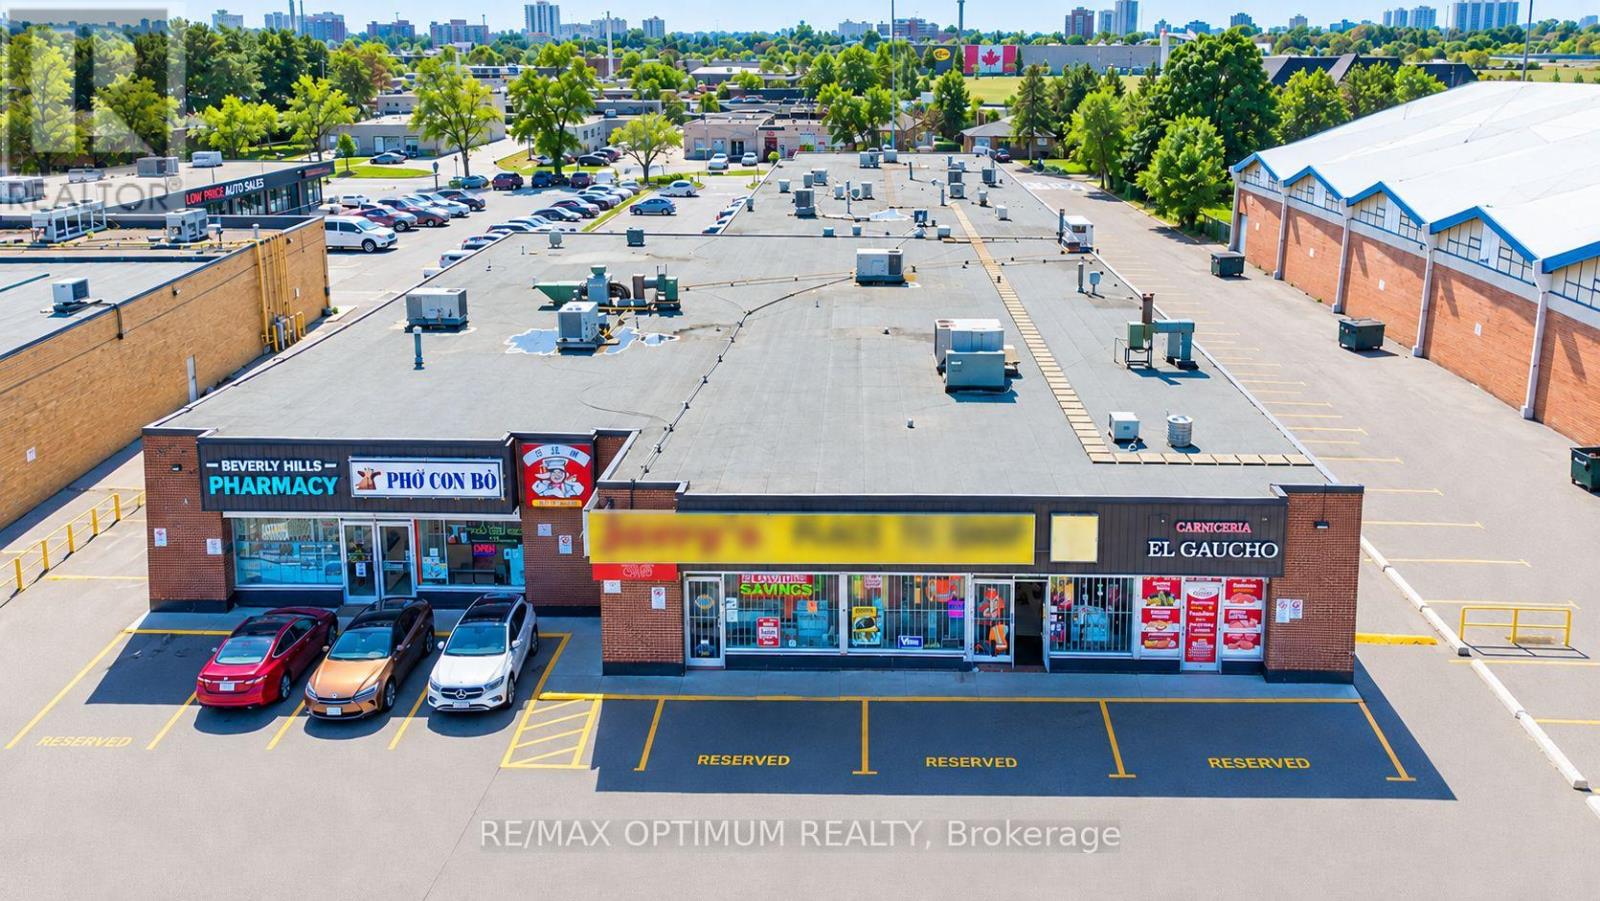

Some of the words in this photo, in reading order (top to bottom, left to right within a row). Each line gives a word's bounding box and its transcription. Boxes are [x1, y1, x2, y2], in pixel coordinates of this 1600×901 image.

[186, 193, 202, 205] LOW
[204, 186, 224, 200] PRICE
[225, 182, 243, 196] AUTO
[244, 178, 264, 192] SALES
[221, 460, 280, 472] BEVERLY
[283, 460, 322, 472] HILLS
[209, 476, 338, 495] PHARMACY
[429, 472, 466, 490] CON
[471, 469, 497, 490] BÒ
[1175, 522, 1252, 534] CARNICERIA
[1147, 541, 1176, 557] EL
[1180, 541, 1279, 558] GAUCHO
[739, 583, 813, 596] SAVINGS
[36, 736, 133, 748] RESERVED
[697, 755, 791, 767] RESERVED
[925, 757, 1018, 768] RESERVED
[1207, 758, 1311, 769] RESERVED
